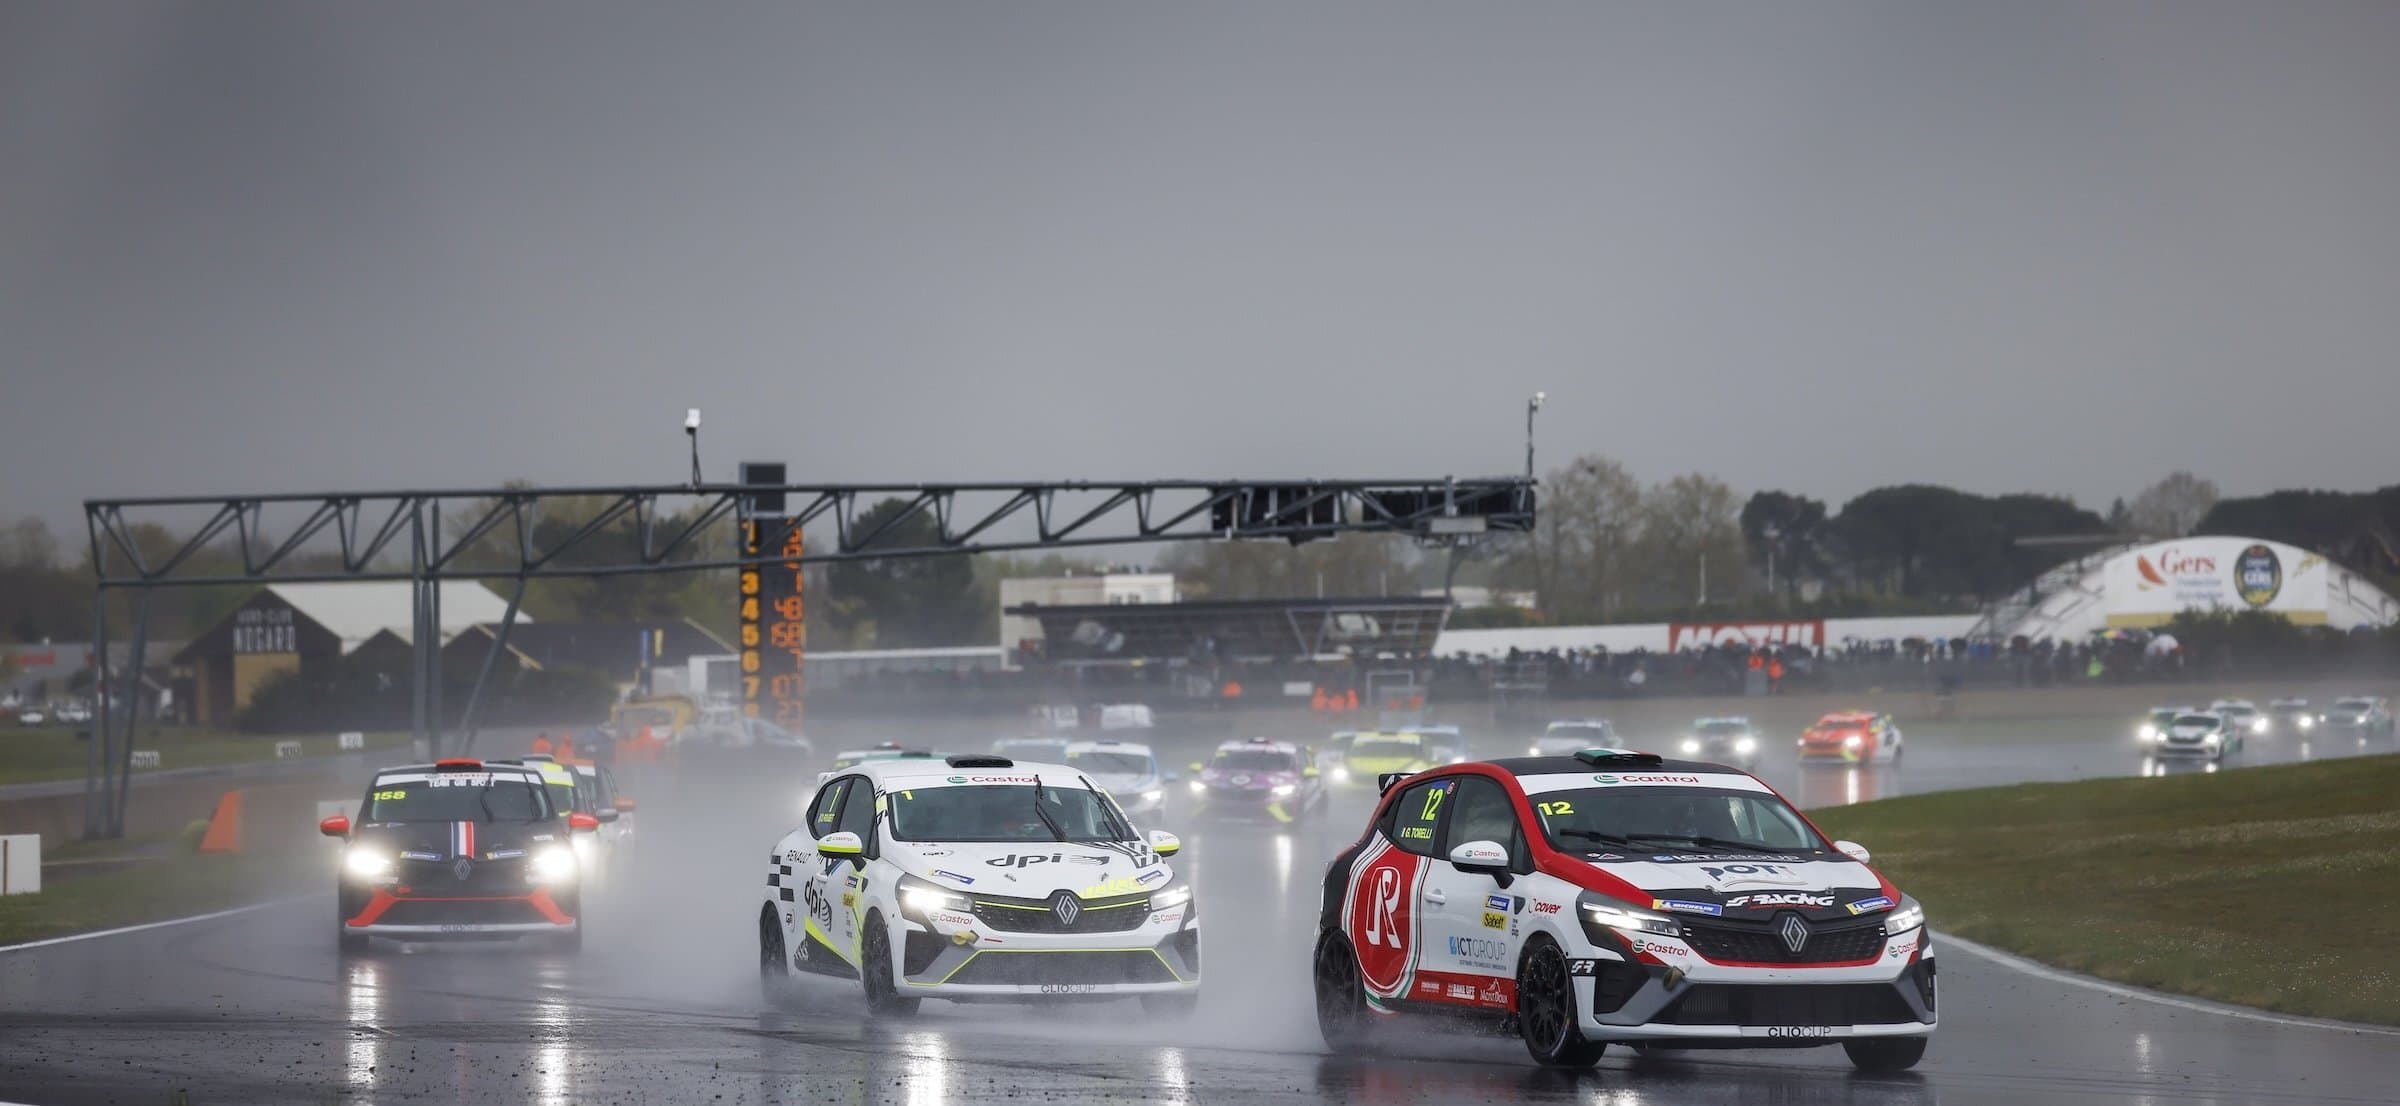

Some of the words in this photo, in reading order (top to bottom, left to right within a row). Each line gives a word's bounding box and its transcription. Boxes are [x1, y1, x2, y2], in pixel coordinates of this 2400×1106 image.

[2161, 549, 2216, 574] Gers
[742, 571, 759, 594] 3
[742, 597, 759, 620] 4
[742, 623, 760, 647] 5
[744, 675, 761, 699] 7
[971, 776, 1040, 784] Castrol
[1623, 775, 1699, 783] Castrol
[373, 791, 406, 800] 158
[1421, 788, 1443, 820] 12
[1537, 801, 1574, 816] 12
[1411, 827, 1432, 839] TORELLI
[986, 853, 1062, 868] dpi
[1673, 903, 1714, 912] MICHELIN
[940, 914, 973, 925] Castrol
[1485, 913, 1504, 929] Sabelt
[1457, 937, 1505, 960] ICTGROUP
[1646, 943, 1688, 956] Castrol
[1041, 984, 1095, 992] CLIOCUP
[1768, 1026, 1831, 1037] CLIOCUP
